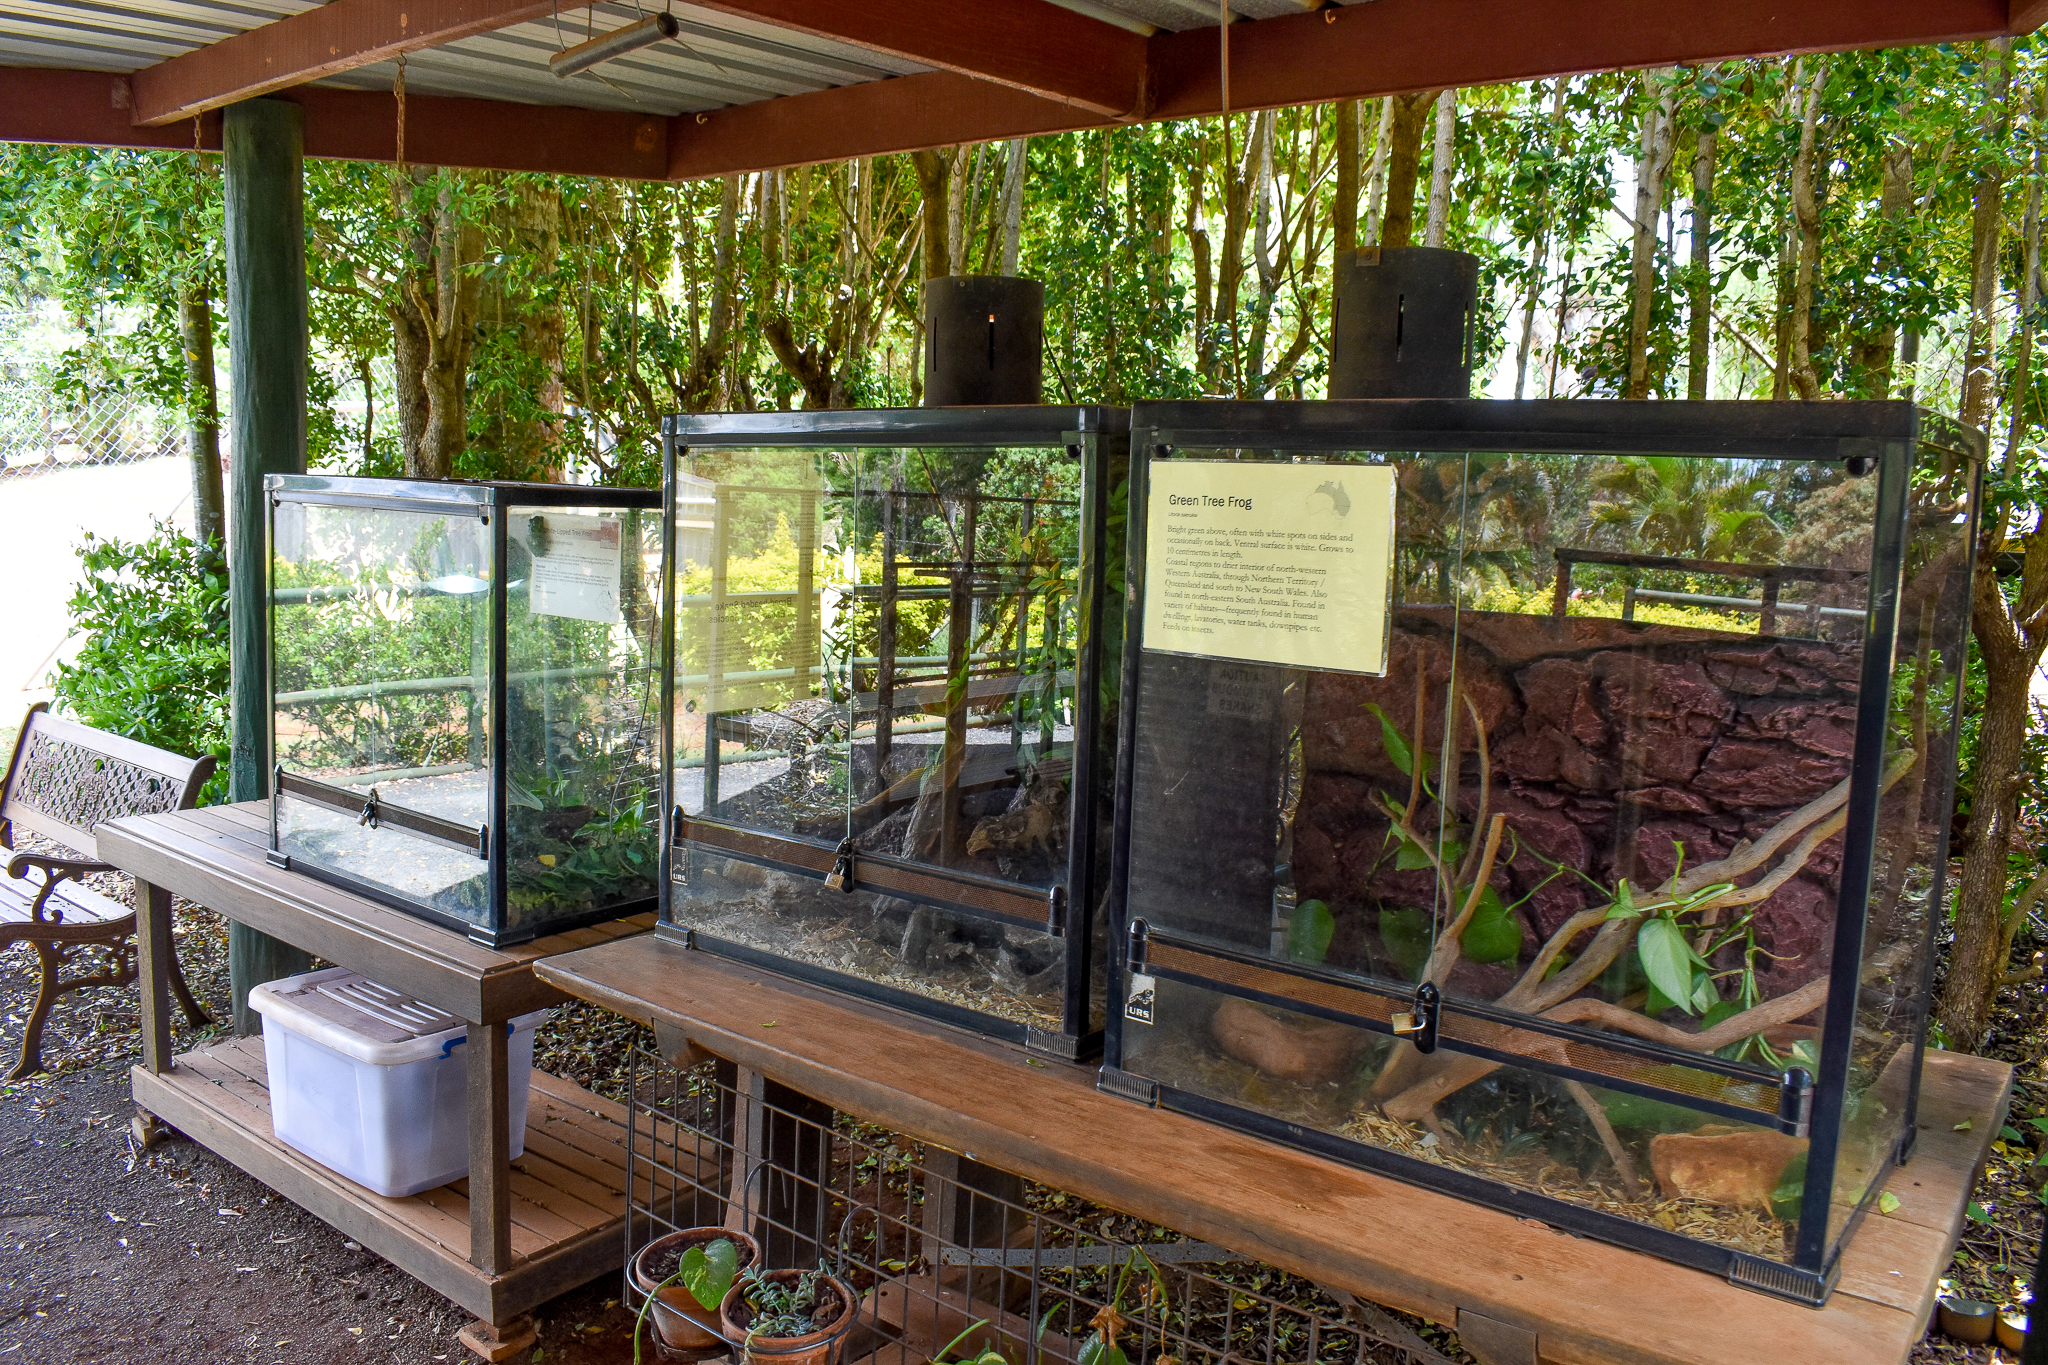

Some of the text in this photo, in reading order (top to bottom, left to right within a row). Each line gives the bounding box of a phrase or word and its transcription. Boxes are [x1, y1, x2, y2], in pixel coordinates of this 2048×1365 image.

[1169, 495, 1253, 510] Green Tree Frog
[1167, 526, 1187, 535] Bright
[1207, 527, 1228, 536] above,
[1229, 528, 1247, 536] often
[1249, 529, 1265, 537] with
[1266, 530, 1285, 538] white
[1287, 531, 1307, 541] spots
[1320, 532, 1337, 540] sides
[1339, 533, 1353, 541] and
[1167, 537, 1203, 547] occasionally
[1215, 539, 1232, 547] back.
[1234, 540, 1259, 548] Ventral
[1261, 541, 1286, 549] surface
[1295, 543, 1317, 551] white.
[1319, 544, 1344, 552] Grows
[1176, 548, 1211, 556] centimetres
[1220, 550, 1243, 560] length.
[1166, 558, 1188, 566] Coastal
[1190, 560, 1212, 569] regions
[1222, 561, 1238, 569] drier
[1240, 562, 1265, 571] interior
[1165, 569, 1190, 577] Western
[1192, 571, 1222, 580] Australia,
[1223, 573, 1250, 583] through
[1251, 574, 1284, 583] Northern
[1286, 577, 1318, 588] Territory
[1165, 580, 1201, 591] Queensland
[1202, 582, 1214, 590] and
[1216, 583, 1234, 591] south
[1245, 585, 1262, 593] New
[1263, 586, 1284, 595] South
[1286, 588, 1309, 596] Wales.
[1311, 590, 1328, 598] Also
[1236, 596, 1256, 604] South
[1257, 597, 1291, 606] Australia.
[1292, 600, 1316, 608] Found
[1164, 601, 1184, 611] variety
[1262, 609, 1283, 617] found
[1293, 611, 1318, 620] human
[1163, 622, 1181, 630] Feeds
[1228, 617, 1246, 625] water
[1248, 619, 1268, 628] tanks,
[1269, 621, 1308, 633] downpipes
[673, 873, 686, 882] URS
[1128, 1006, 1150, 1019] URS
